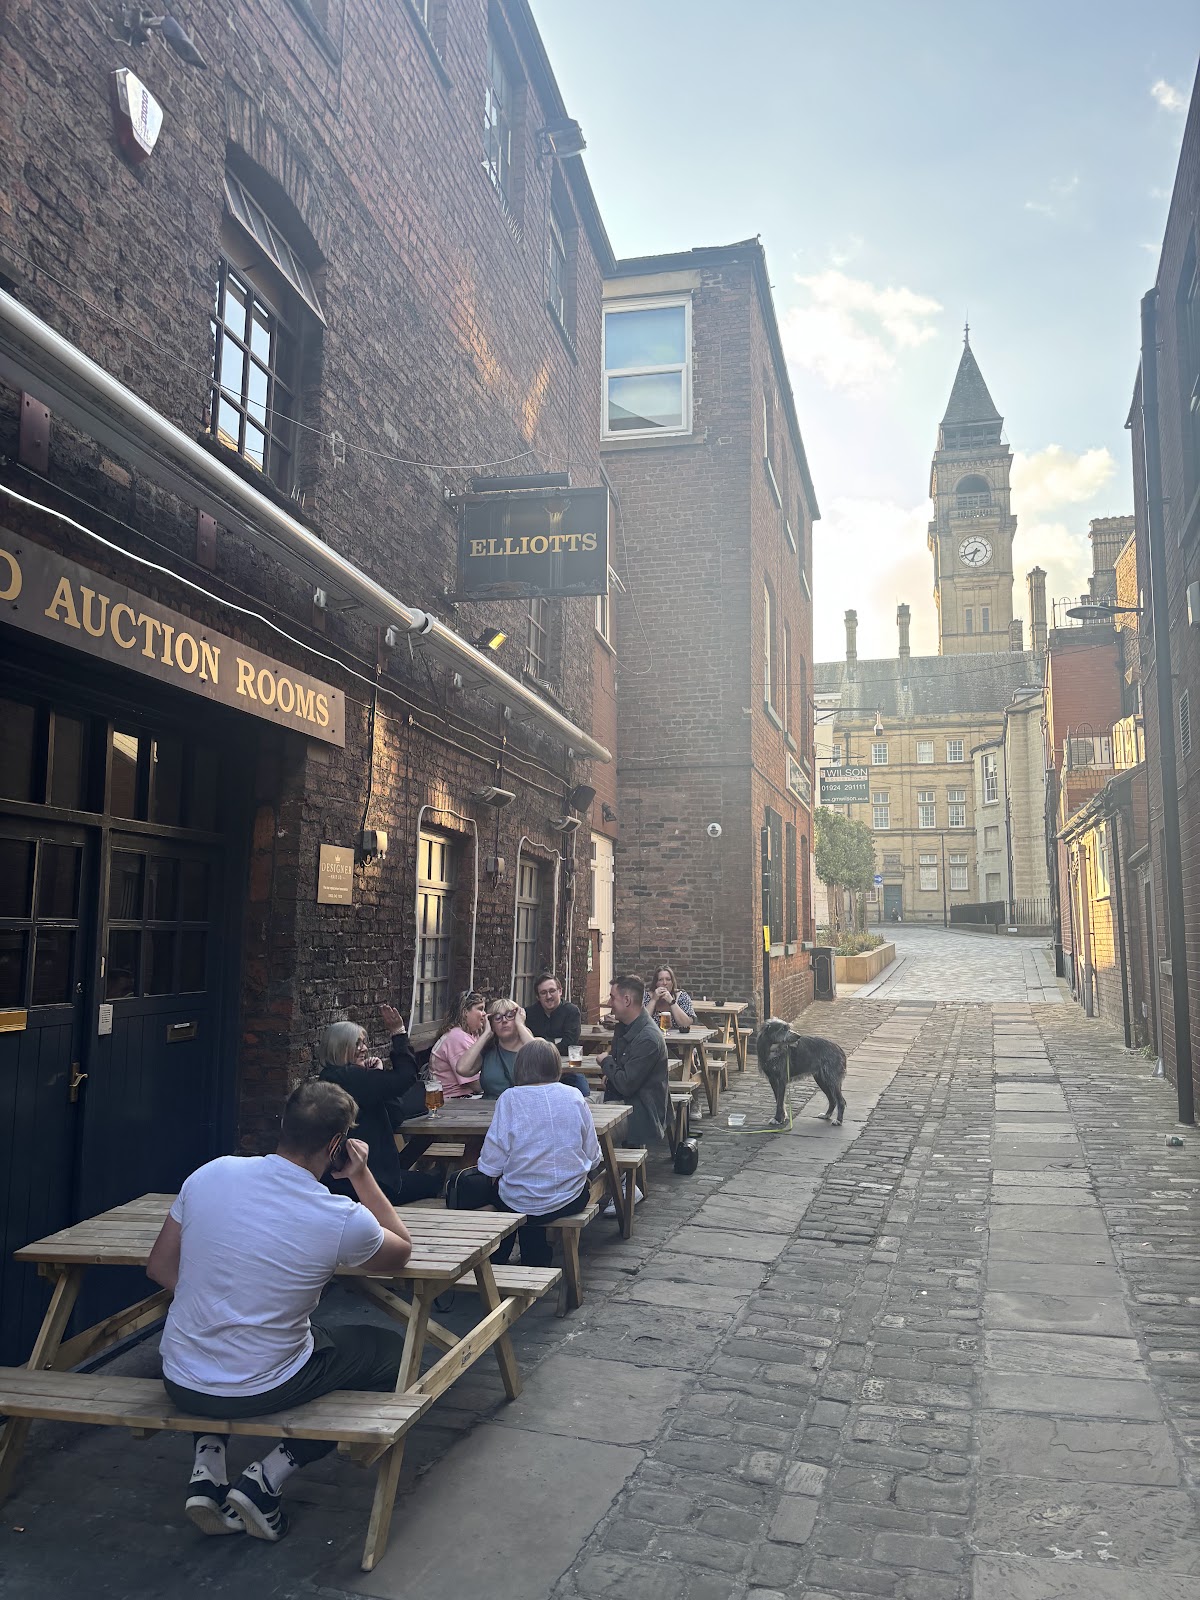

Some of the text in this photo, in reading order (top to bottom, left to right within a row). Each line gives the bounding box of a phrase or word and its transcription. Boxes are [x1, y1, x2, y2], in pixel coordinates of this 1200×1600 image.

[469, 532, 598, 557] ELLIOTTS
[44, 576, 220, 684] AUCTION
[235, 657, 329, 727] ROOMS
[826, 768, 868, 777] WILSON
